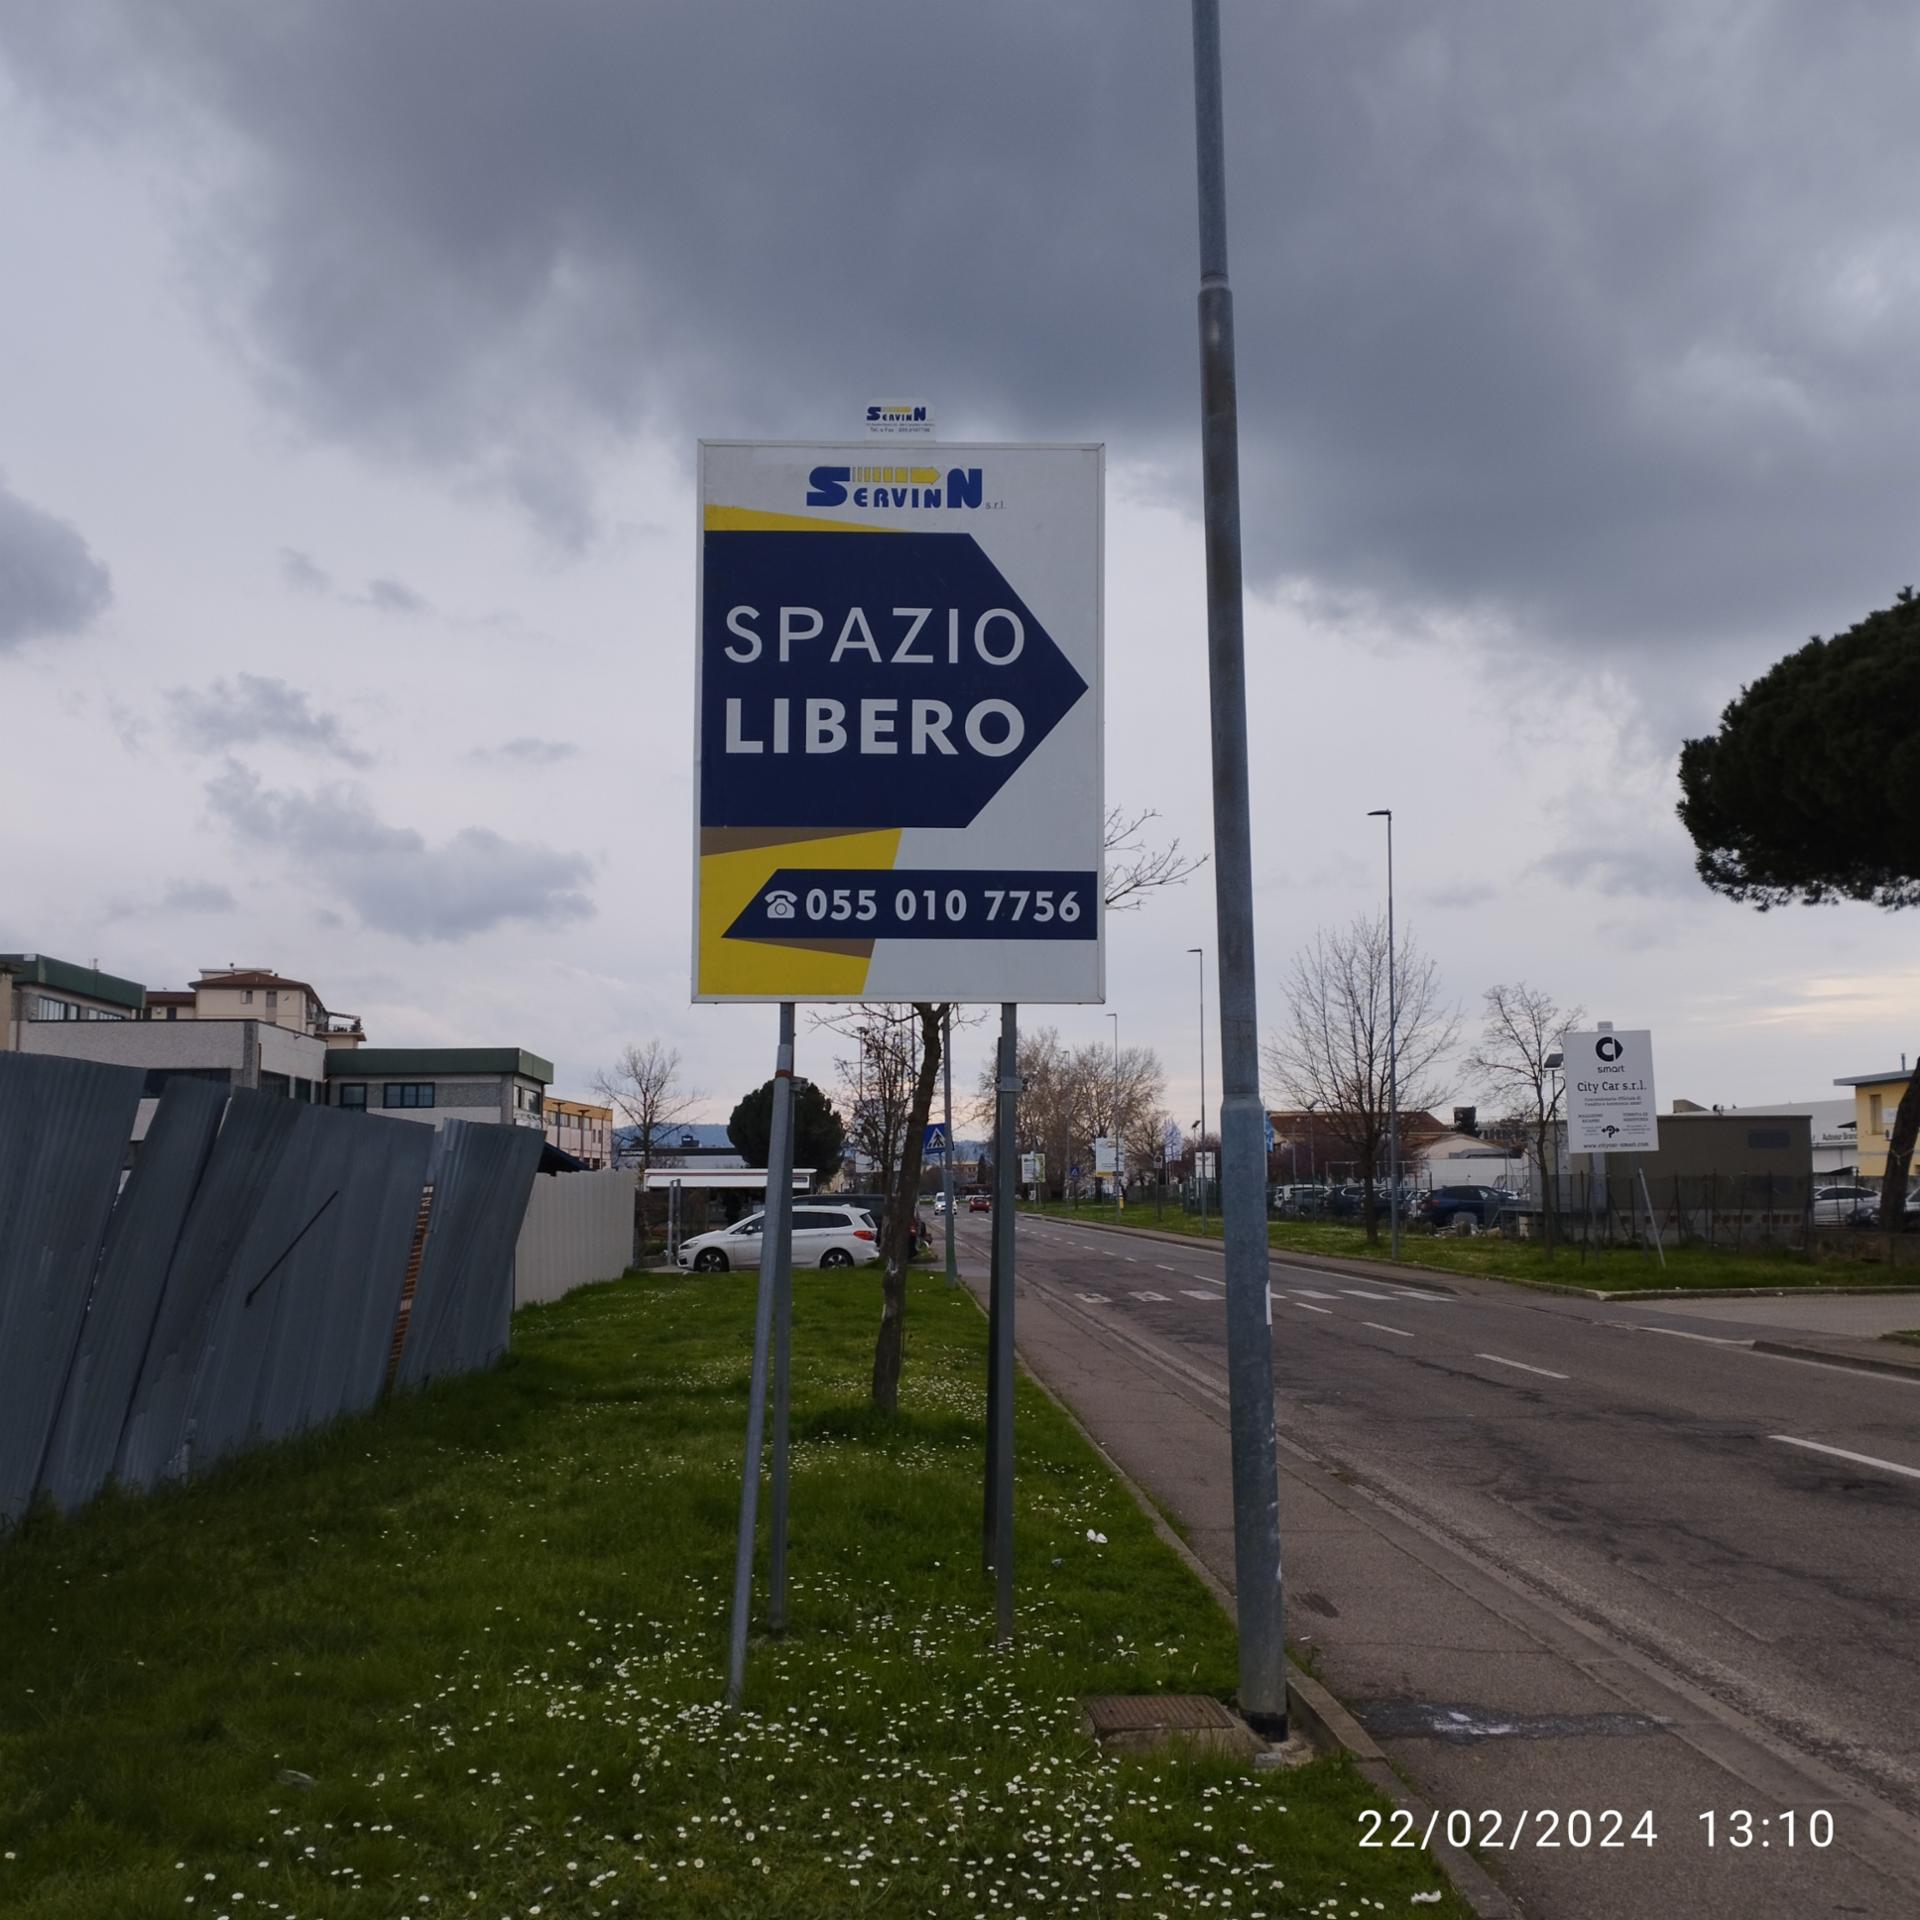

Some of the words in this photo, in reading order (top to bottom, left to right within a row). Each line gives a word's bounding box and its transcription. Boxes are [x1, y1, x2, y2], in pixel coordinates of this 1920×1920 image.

[724, 605, 1025, 666] SPAZIO
[725, 698, 1025, 757] LIBERO
[805, 888, 878, 921] 055
[895, 889, 967, 922] 010
[984, 890, 1081, 922] 7756
[1598, 1065, 1625, 1073] smart
[1577, 1081, 1599, 1094] City
[1602, 1081, 1619, 1091] Car
[1623, 1080, 1647, 1091] s.r.l.
